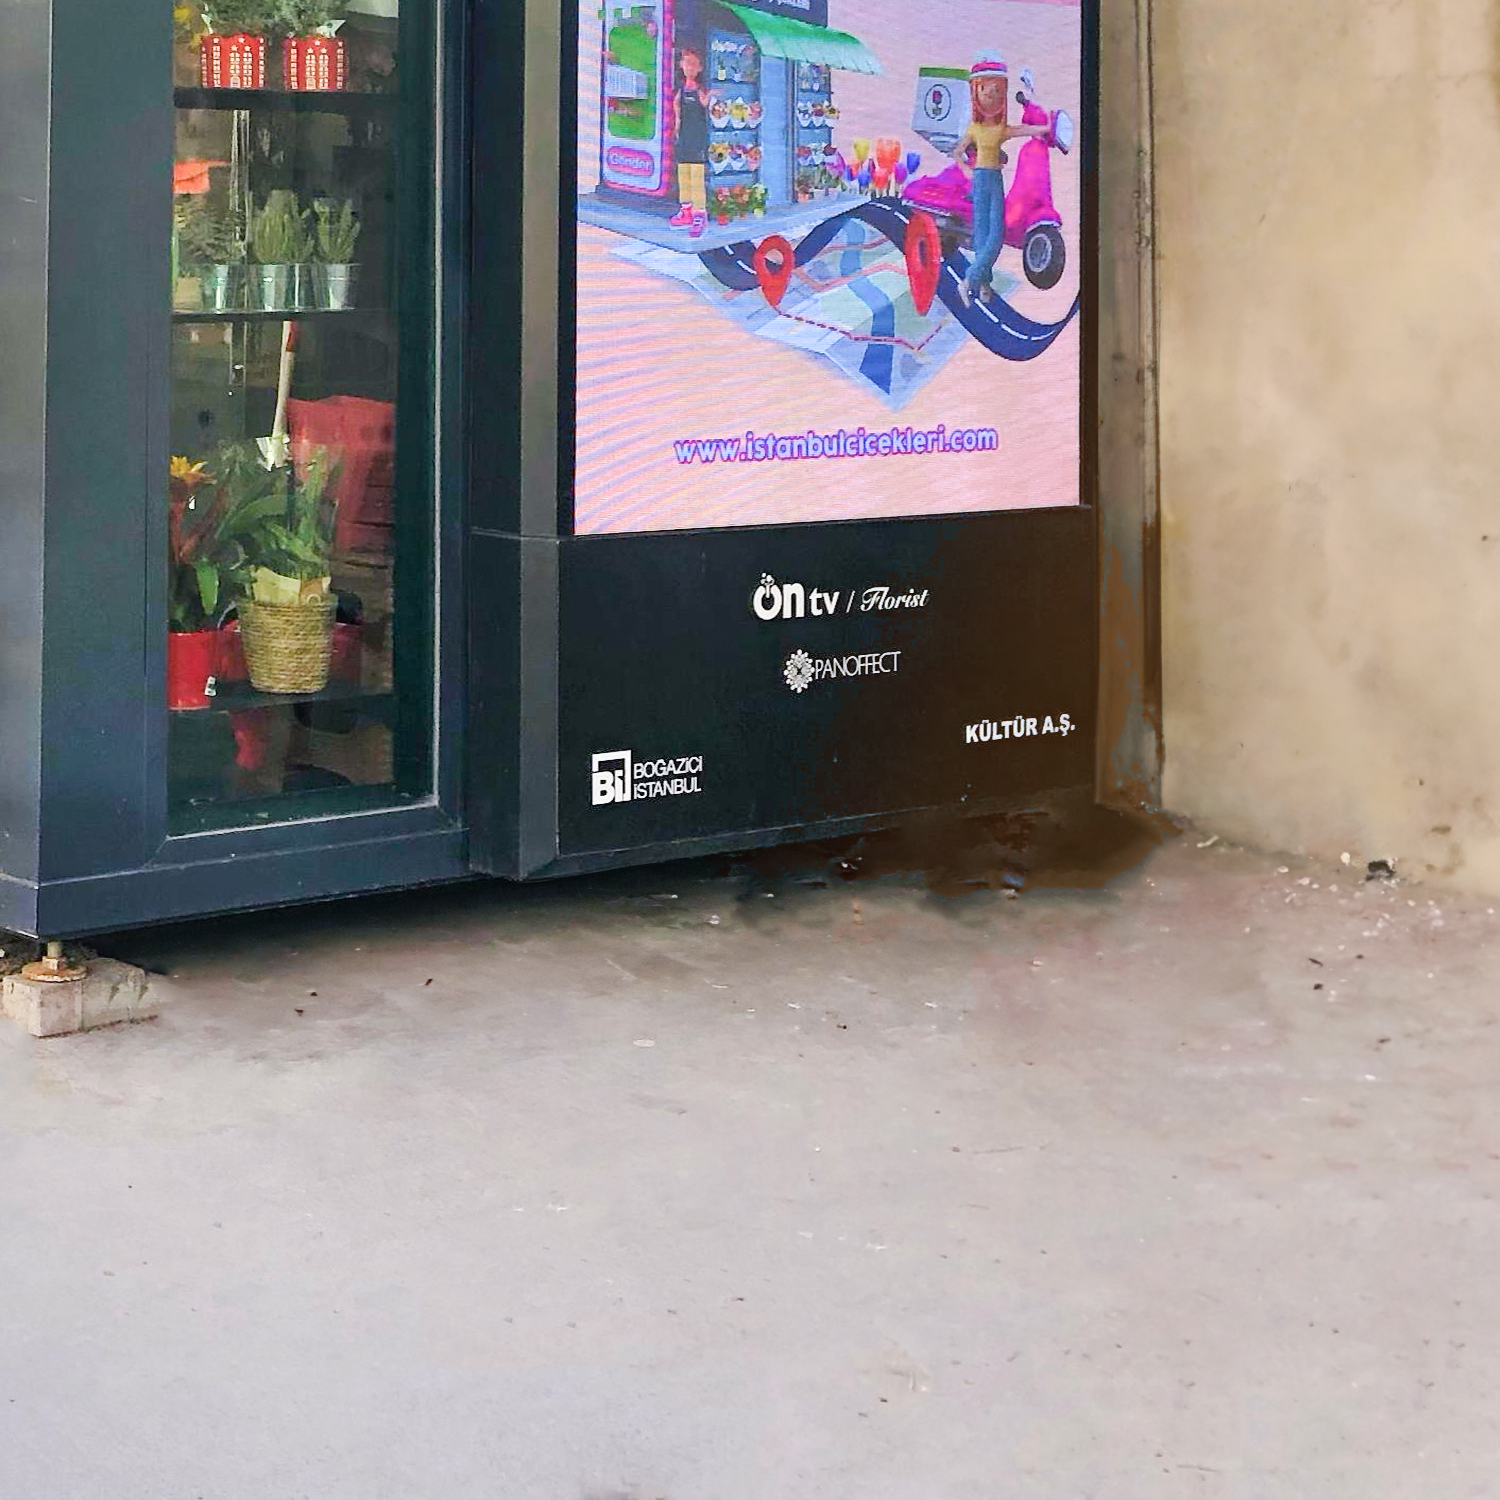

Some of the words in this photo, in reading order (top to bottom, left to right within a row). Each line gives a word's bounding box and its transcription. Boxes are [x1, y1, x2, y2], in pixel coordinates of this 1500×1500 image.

[673, 424, 998, 465] www.istanbulcicekleri.com
[859, 586, 931, 612] Florist
[814, 651, 902, 680] PANOFFECT
[965, 715, 1039, 744] KÜLTÜR
[1041, 713, 1076, 737] A.Ş.
